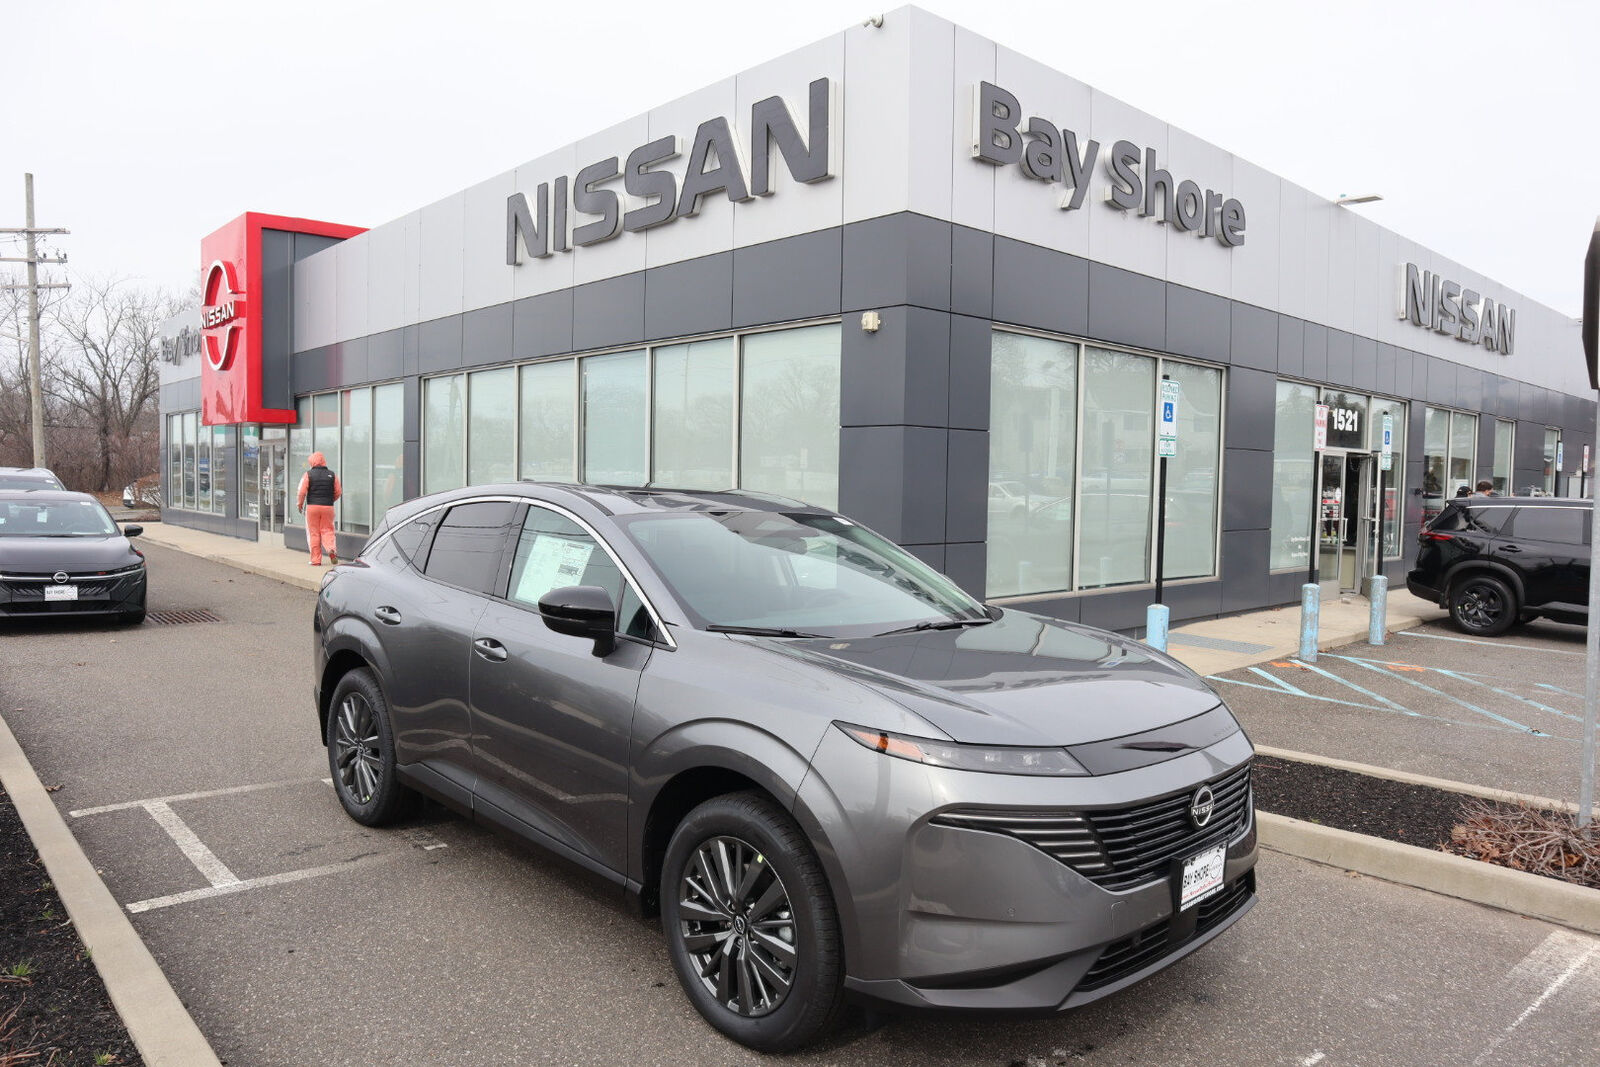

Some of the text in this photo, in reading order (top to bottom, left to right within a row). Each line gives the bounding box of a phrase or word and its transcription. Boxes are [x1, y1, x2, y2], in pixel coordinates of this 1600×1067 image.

[506, 77, 830, 266] NISSAN
[976, 80, 1247, 247] Bay Shore
[200, 301, 235, 330] NISSAN
[1404, 262, 1516, 355] NISSAN
[180, 325, 202, 357] Sho
[1332, 408, 1358, 432] 1521
